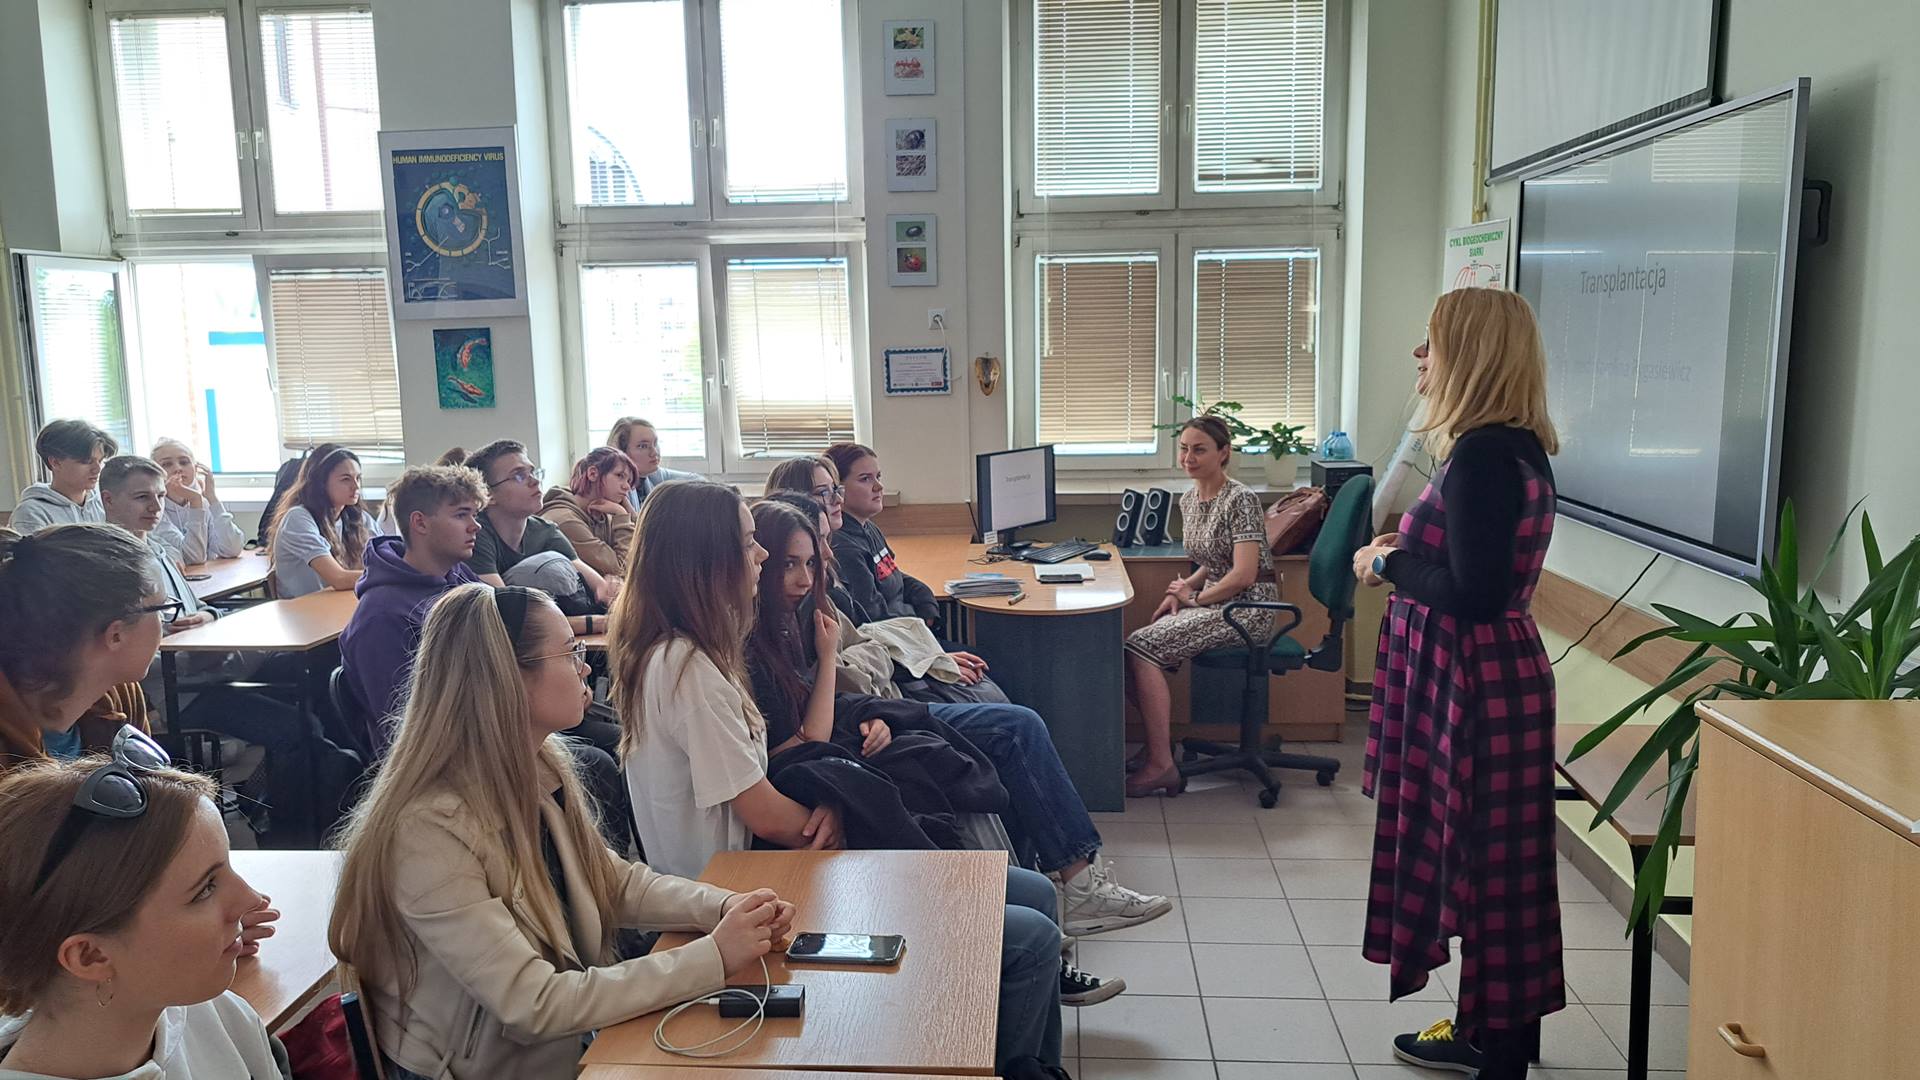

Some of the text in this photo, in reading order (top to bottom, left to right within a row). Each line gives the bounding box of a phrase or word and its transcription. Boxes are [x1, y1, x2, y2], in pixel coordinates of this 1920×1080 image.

[392, 152, 504, 165] HUMAN IMMUNODEFICIENCY VIRUS
[1580, 262, 1666, 298] Transplantacja
